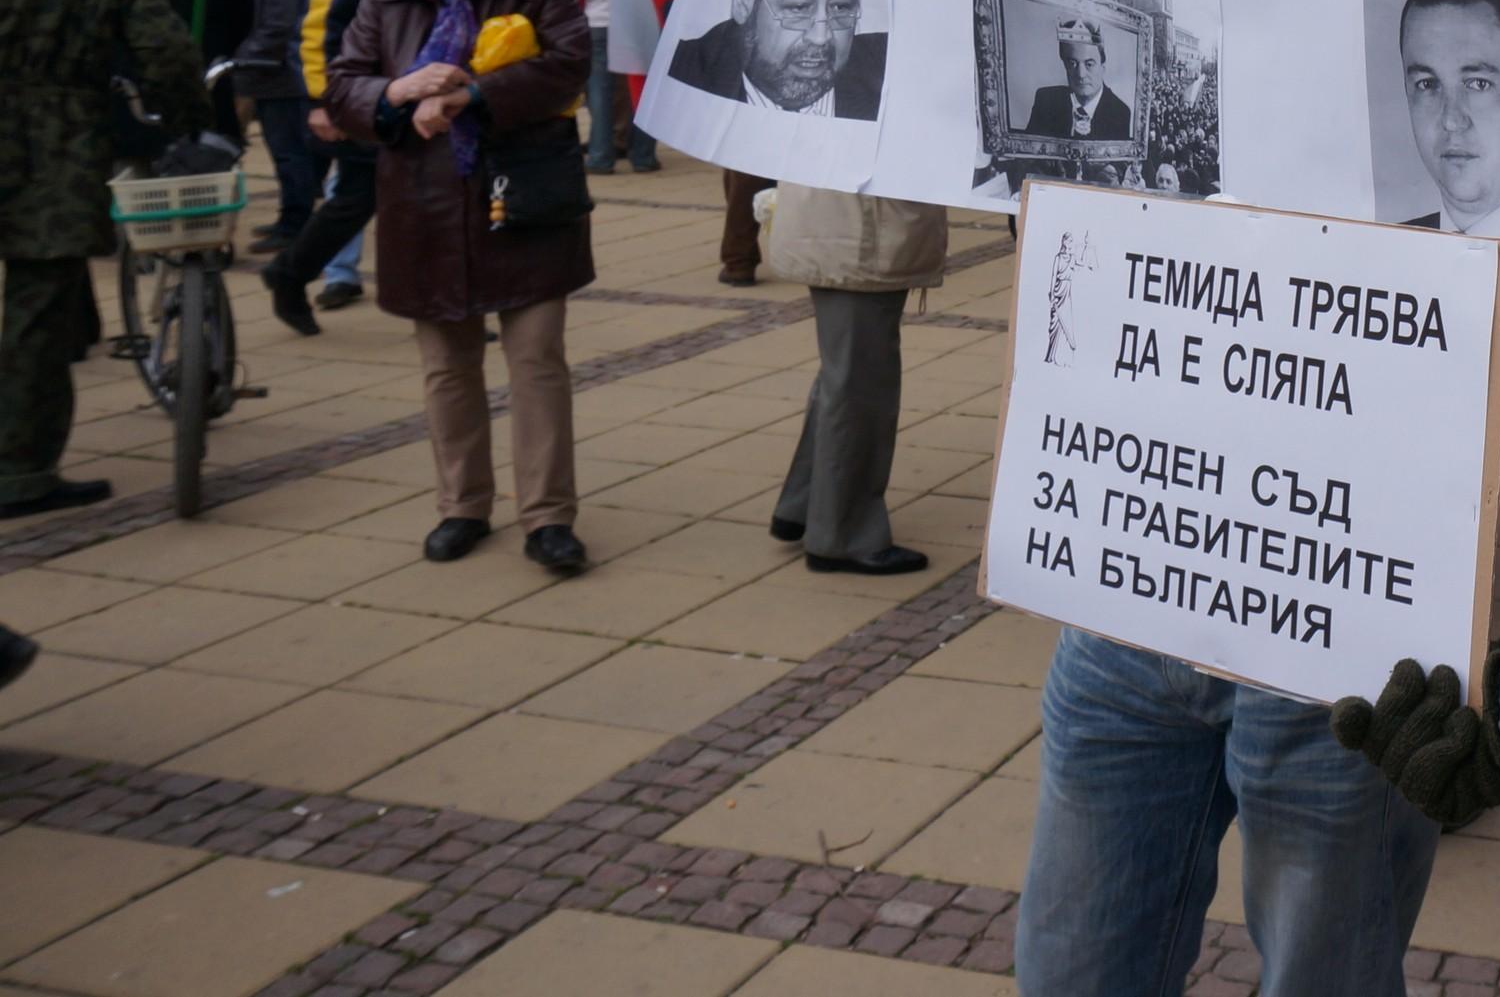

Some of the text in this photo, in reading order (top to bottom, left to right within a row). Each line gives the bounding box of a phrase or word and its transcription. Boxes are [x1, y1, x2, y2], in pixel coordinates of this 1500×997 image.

[1125, 252, 1448, 352] ТЕМИДА ТРЯБВА
[1114, 323, 1354, 416] ДА Е СЛЯПА
[1041, 413, 1352, 534] НАРОДЕН СЪД
[1025, 526, 1333, 649] НА БЪЛГАРИЯ
[1033, 471, 1415, 606] ЗА ГРАБИТЕЛИТЕ
